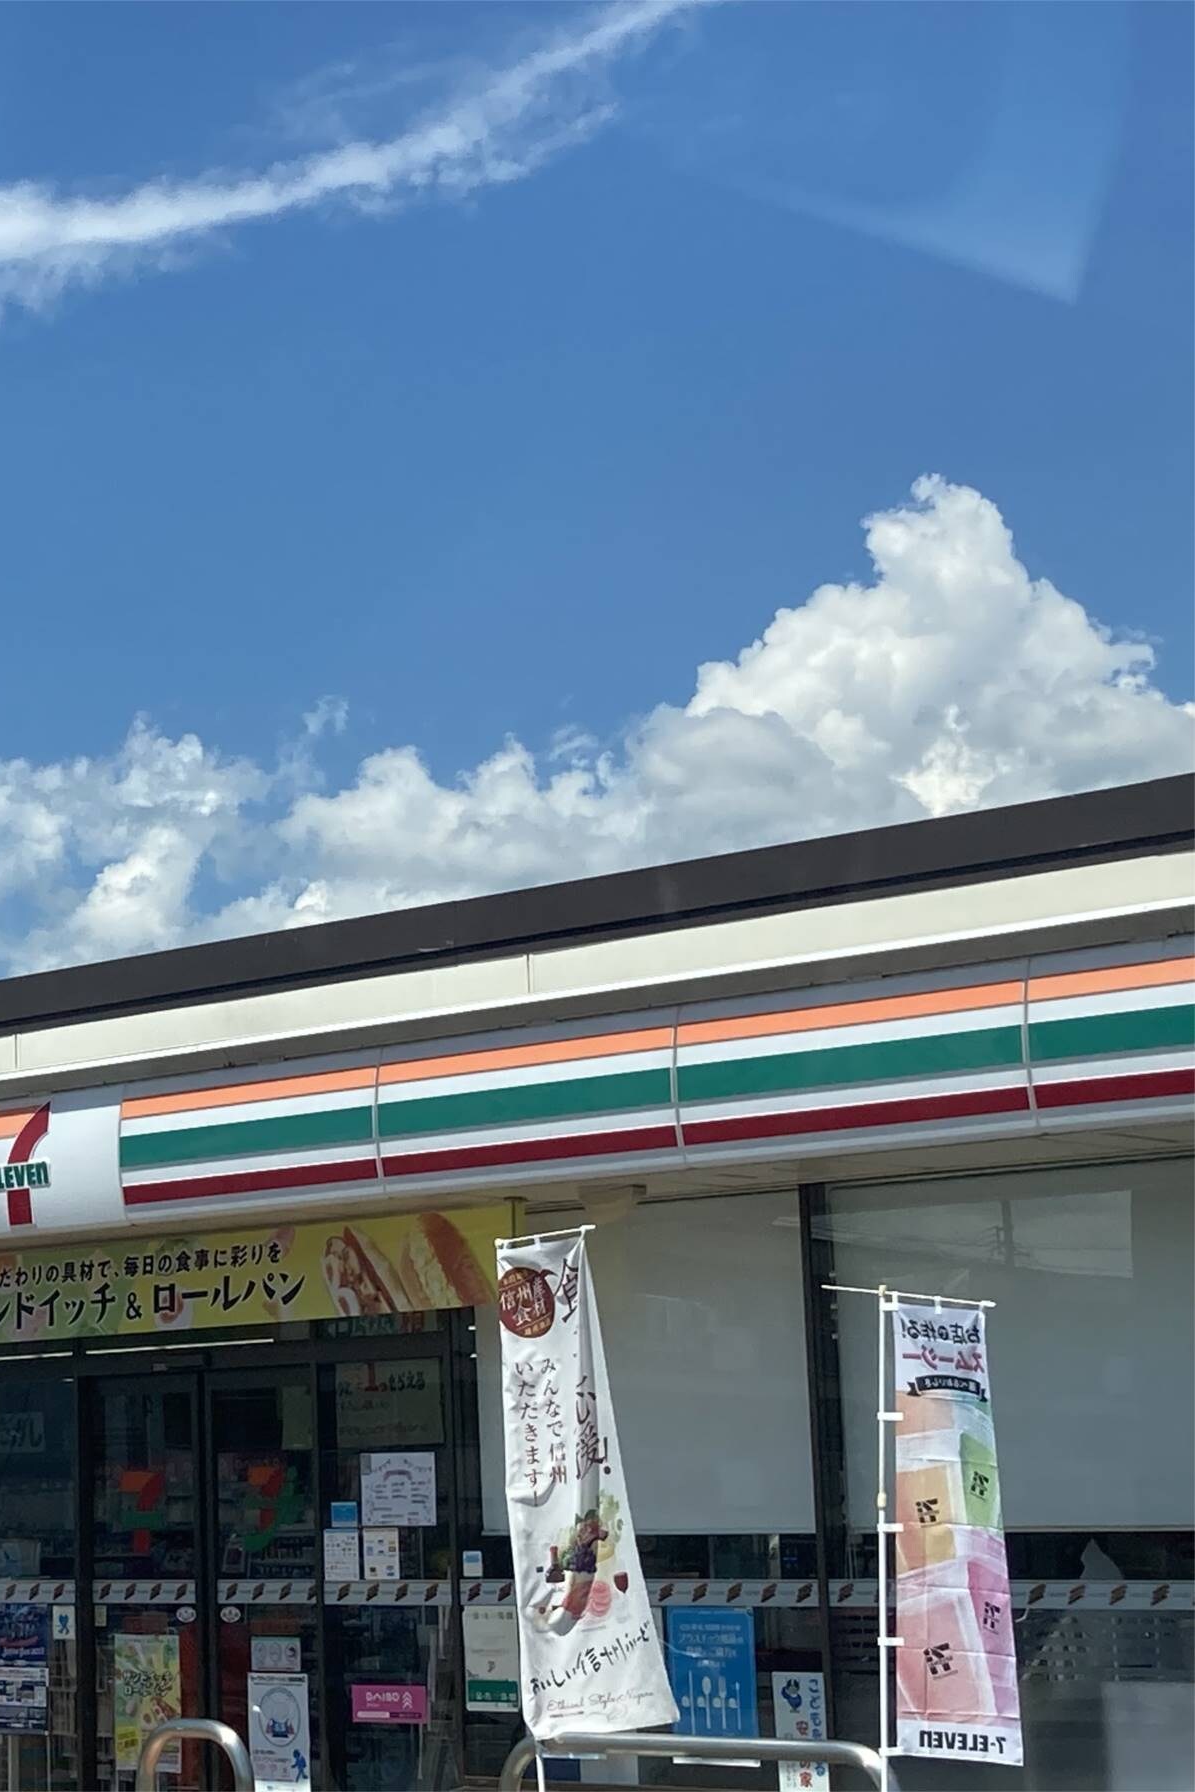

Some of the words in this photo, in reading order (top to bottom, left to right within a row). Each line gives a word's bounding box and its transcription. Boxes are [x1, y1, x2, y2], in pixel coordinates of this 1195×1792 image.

[540, 1357, 568, 1485] みんなで信州
